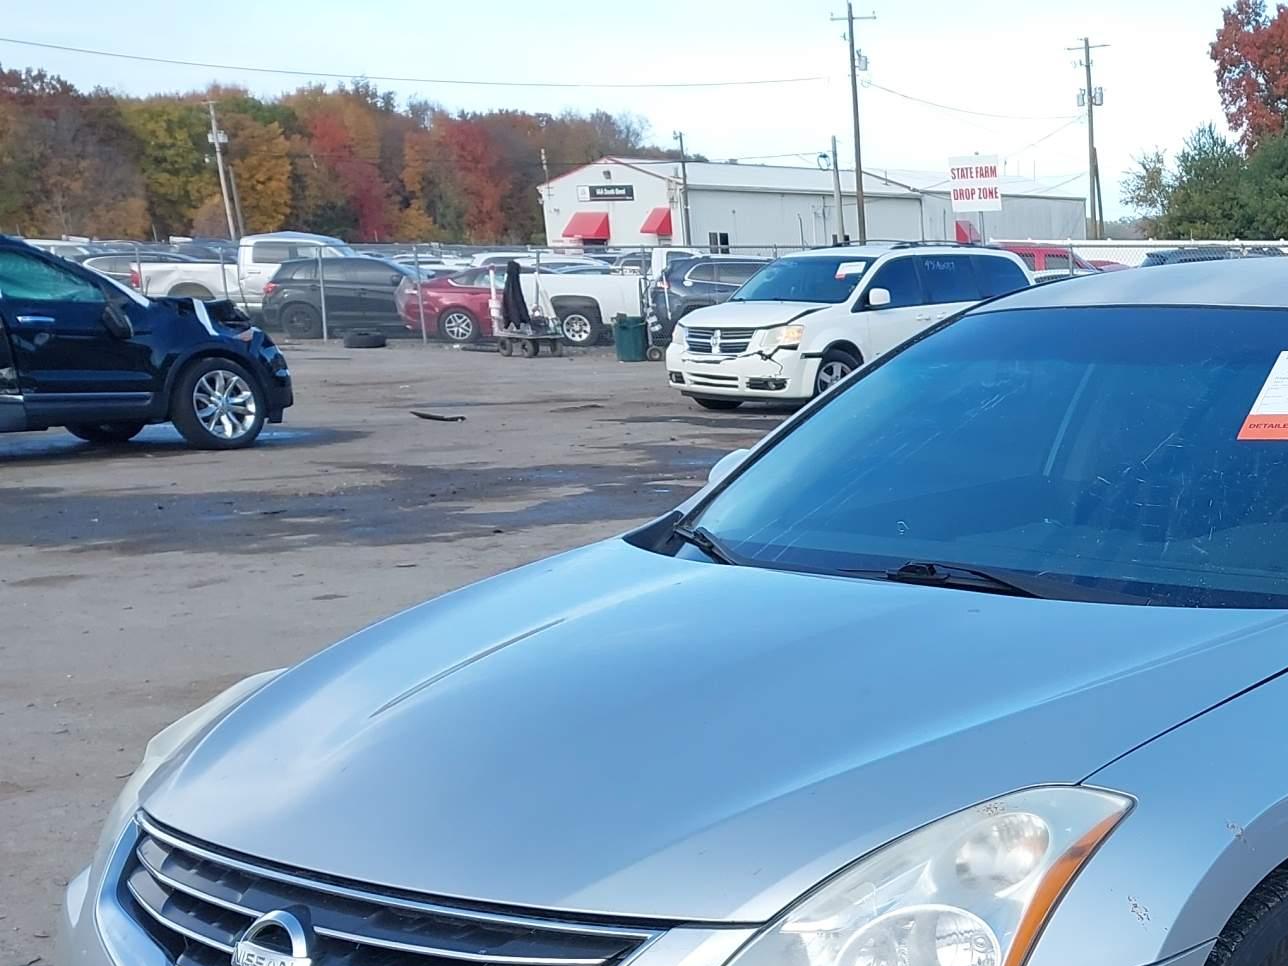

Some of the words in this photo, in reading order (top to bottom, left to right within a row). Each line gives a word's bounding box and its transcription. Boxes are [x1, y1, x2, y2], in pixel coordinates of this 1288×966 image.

[950, 166, 975, 180] STATE
[975, 165, 998, 178] FARM
[952, 188, 976, 201] DROP
[977, 186, 999, 200] ZONE
